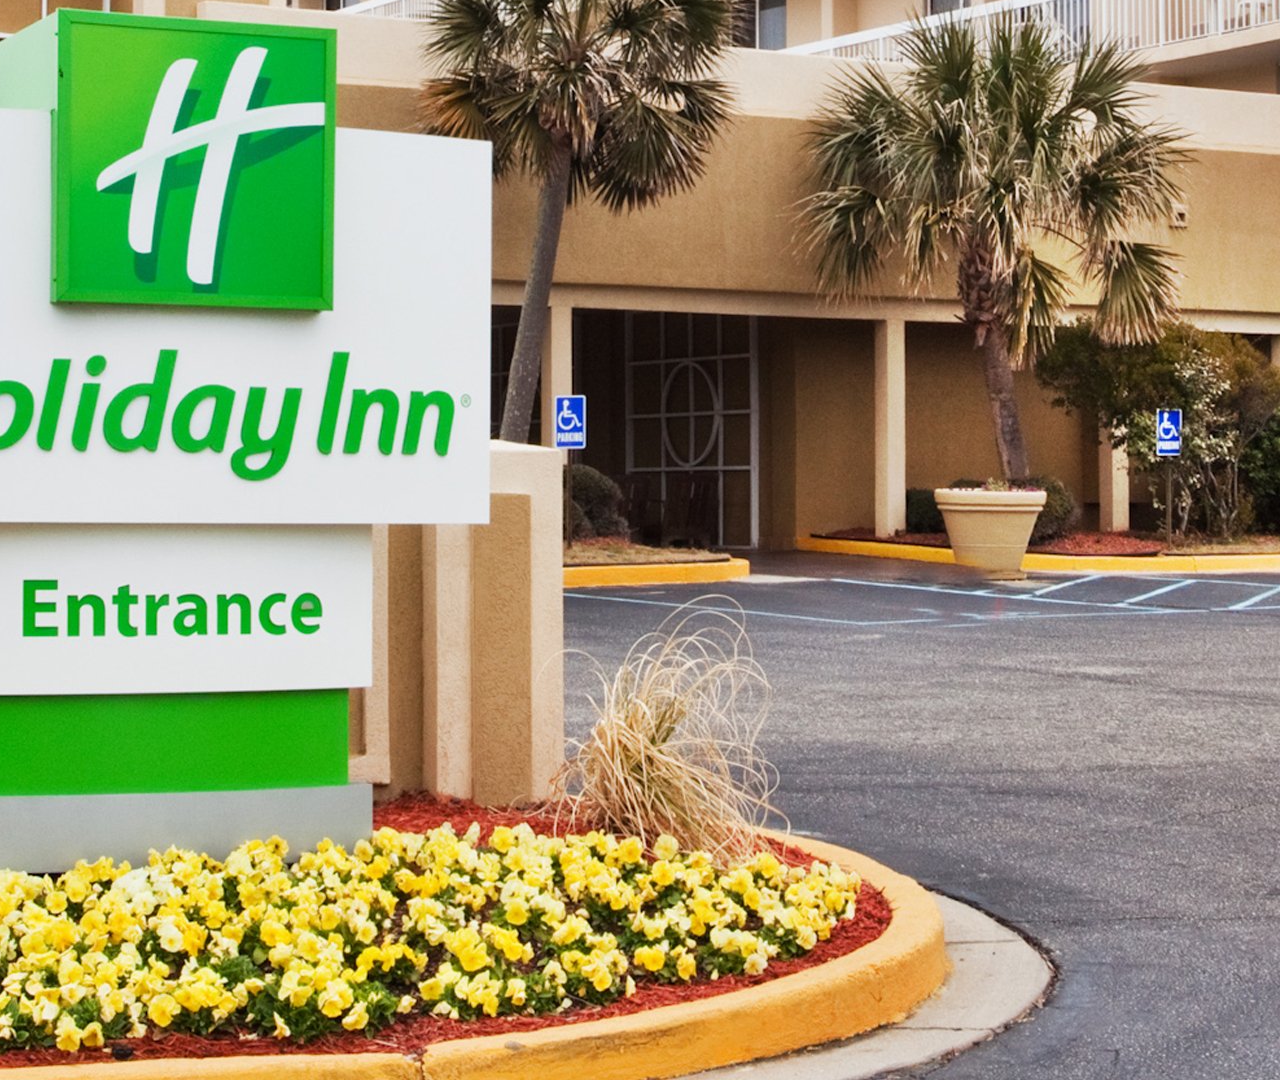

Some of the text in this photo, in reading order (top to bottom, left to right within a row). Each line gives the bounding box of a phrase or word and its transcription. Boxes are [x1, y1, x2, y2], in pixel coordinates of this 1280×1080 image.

[97, 46, 325, 285] H
[317, 351, 455, 457] Inn
[557, 432, 584, 442] PARKING
[22, 579, 323, 638] Entrance
